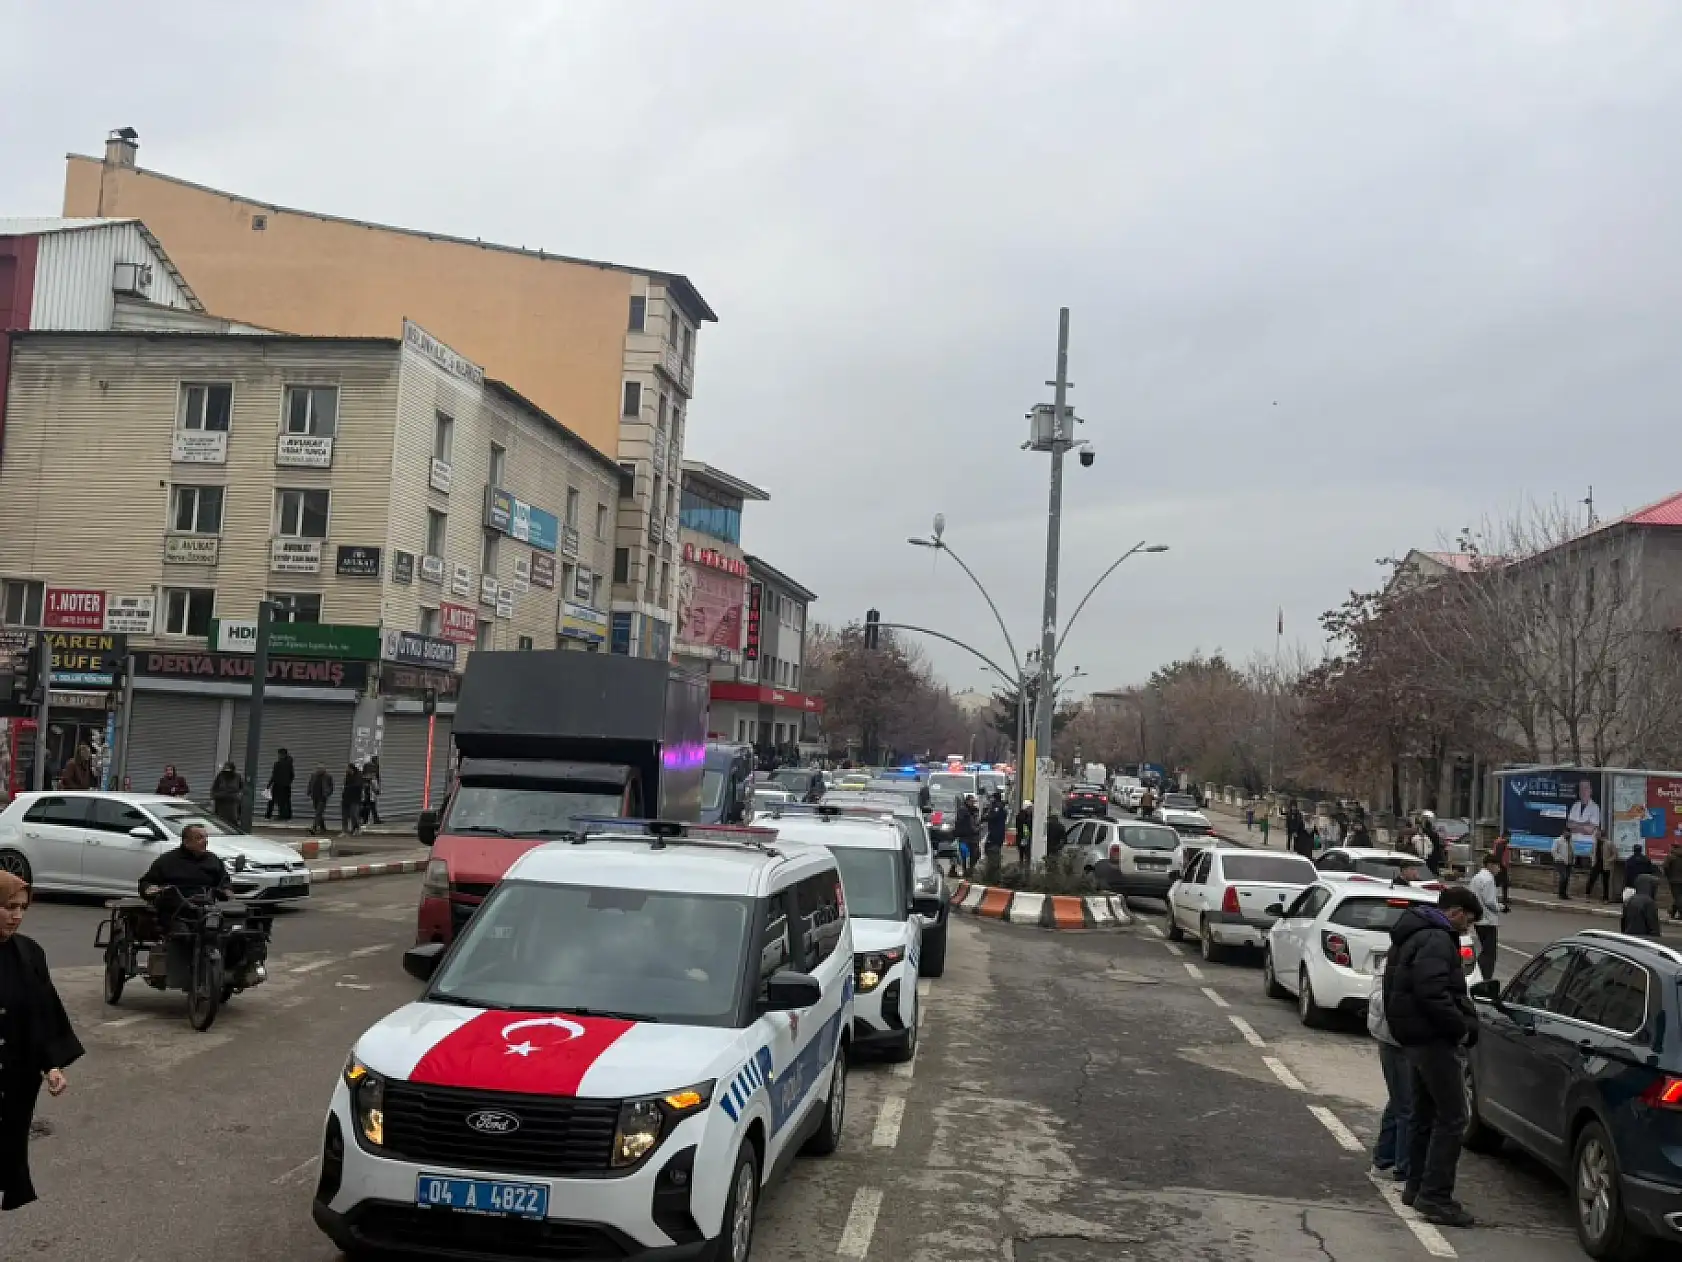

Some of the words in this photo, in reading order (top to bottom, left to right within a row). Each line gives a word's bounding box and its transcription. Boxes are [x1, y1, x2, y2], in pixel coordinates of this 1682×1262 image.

[49, 593, 101, 612] 1.NOTER
[43, 633, 114, 650] YAREN
[228, 626, 256, 639] HDI
[49, 651, 103, 671] BÜFE
[148, 653, 216, 675] DERYA
[475, 1113, 508, 1131] Ford
[429, 1180, 452, 1204] 04
[465, 1182, 477, 1208] A
[490, 1185, 538, 1212] 4822
